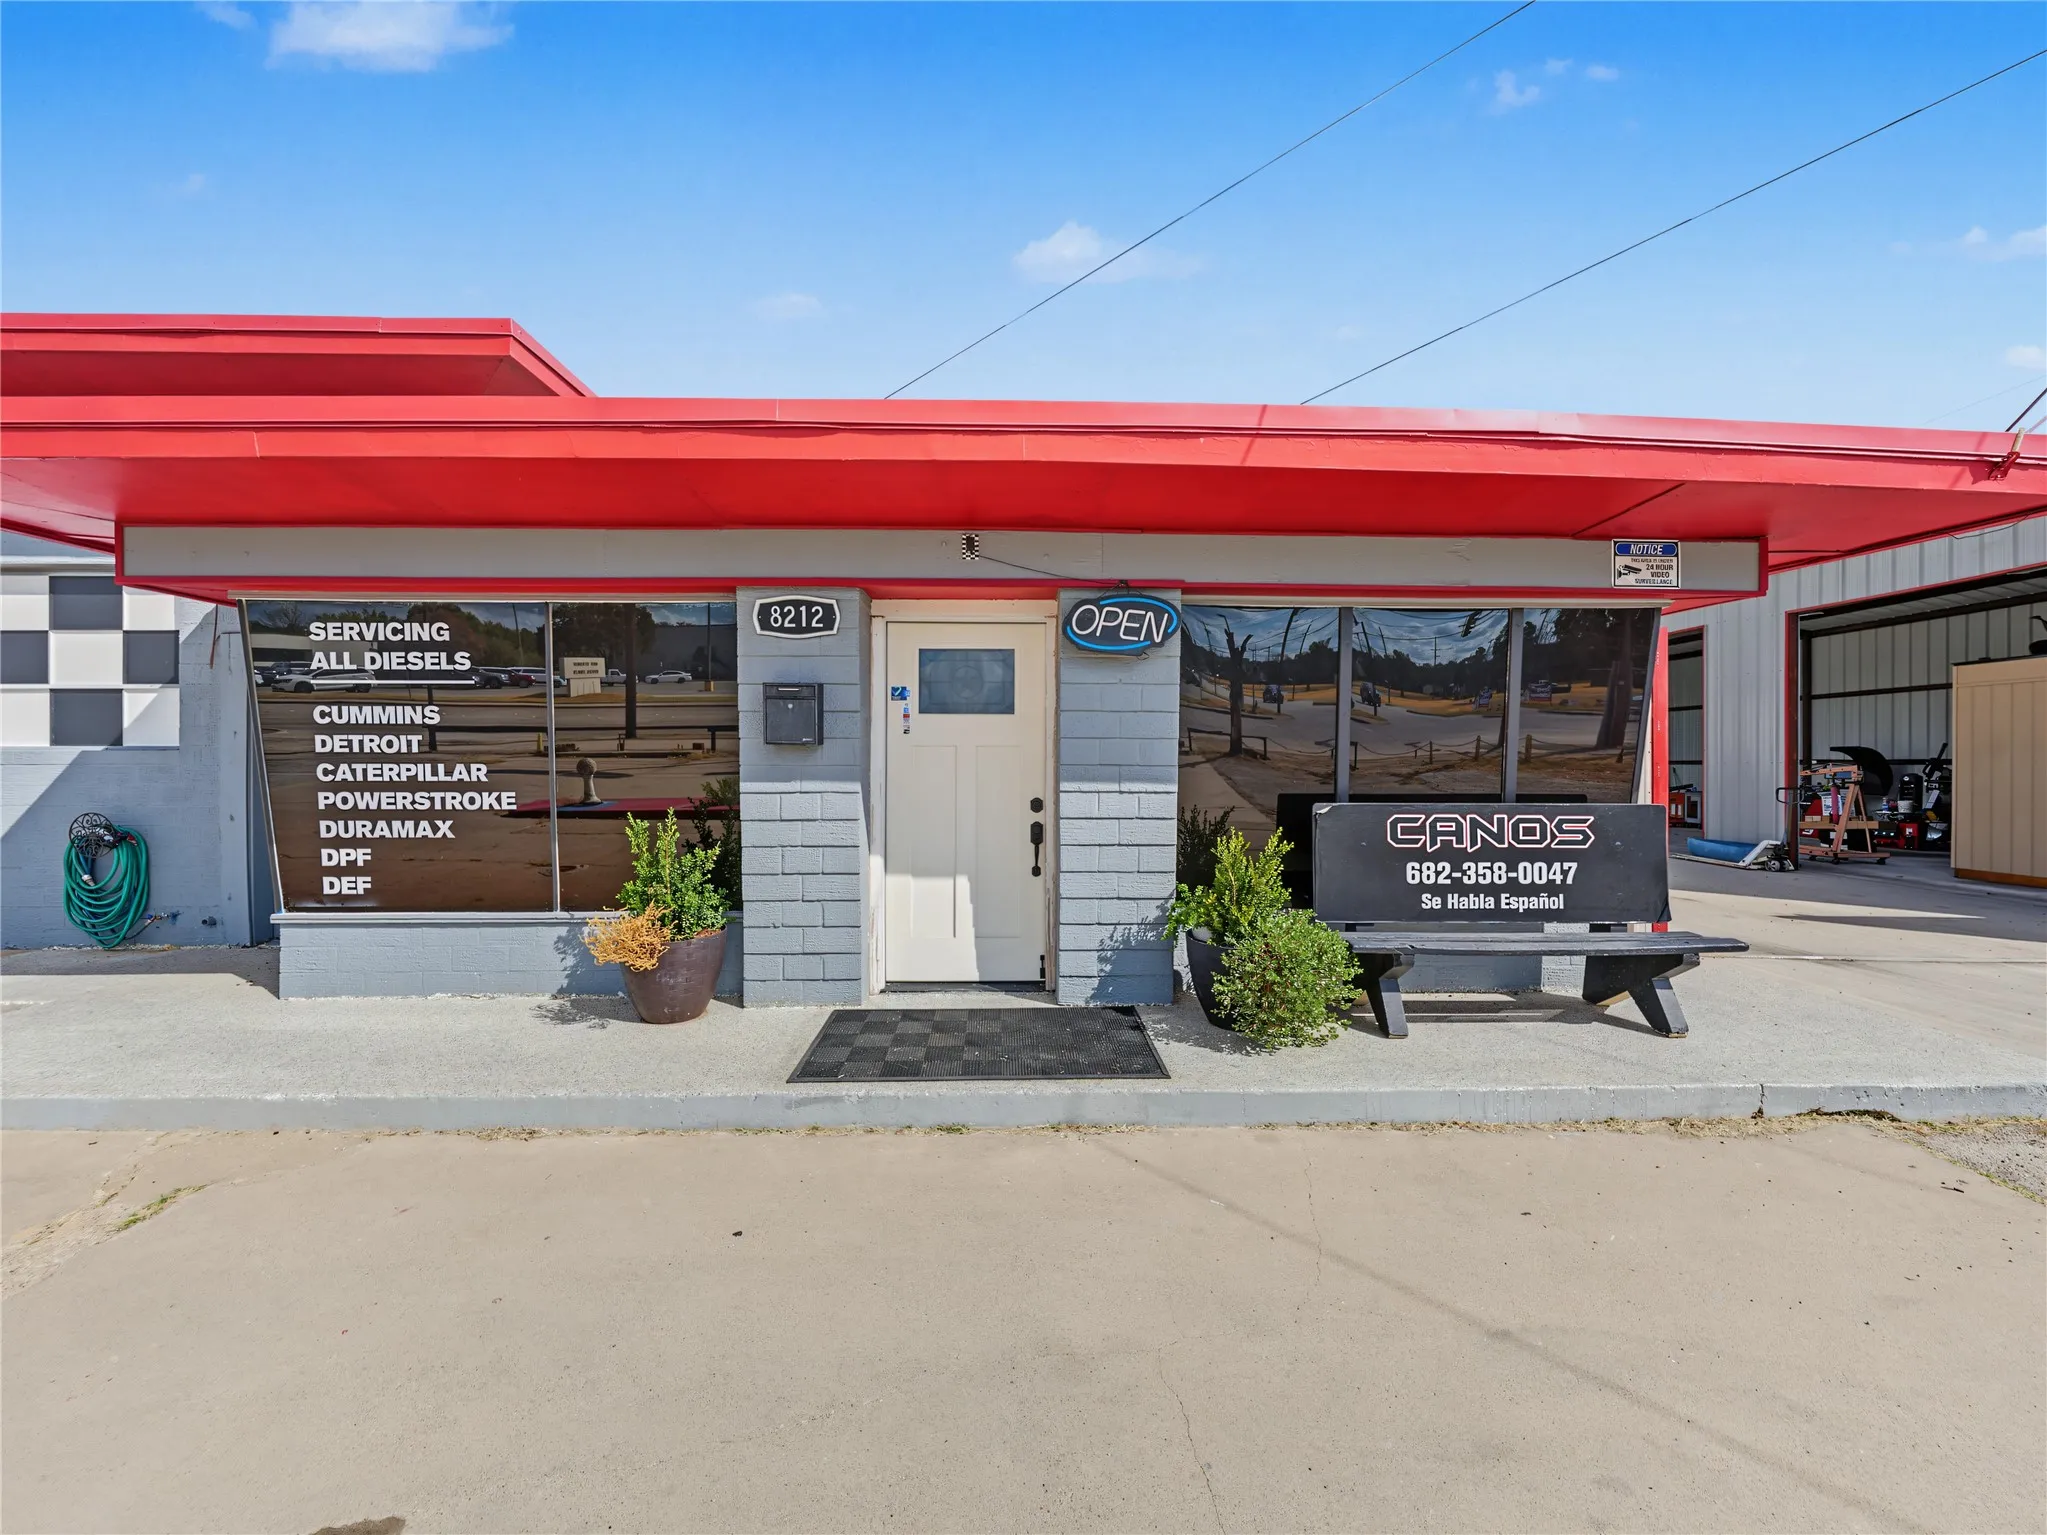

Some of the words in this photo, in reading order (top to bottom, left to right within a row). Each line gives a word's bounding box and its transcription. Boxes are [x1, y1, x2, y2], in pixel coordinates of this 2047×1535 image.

[1630, 544, 1664, 554] NOTICE
[770, 605, 824, 628] 8212
[1072, 604, 1169, 643] OPEN
[309, 621, 450, 642] SERVICING
[310, 651, 357, 670] ALL
[364, 651, 472, 671] DIESELS
[312, 705, 441, 725] CUMMINS
[314, 734, 423, 754] DETROIT
[316, 763, 488, 782] CATERPILLAR
[317, 791, 518, 811] POWERSTROKE
[319, 820, 456, 839] DURAMAX
[1386, 813, 1596, 853] CANOS
[320, 848, 372, 867] DPF
[1405, 861, 1578, 885] 682-358-0047
[322, 876, 372, 895] DEF
[1421, 893, 1442, 909] Se
[1447, 893, 1495, 910] Habla
[1500, 892, 1564, 913] Español
